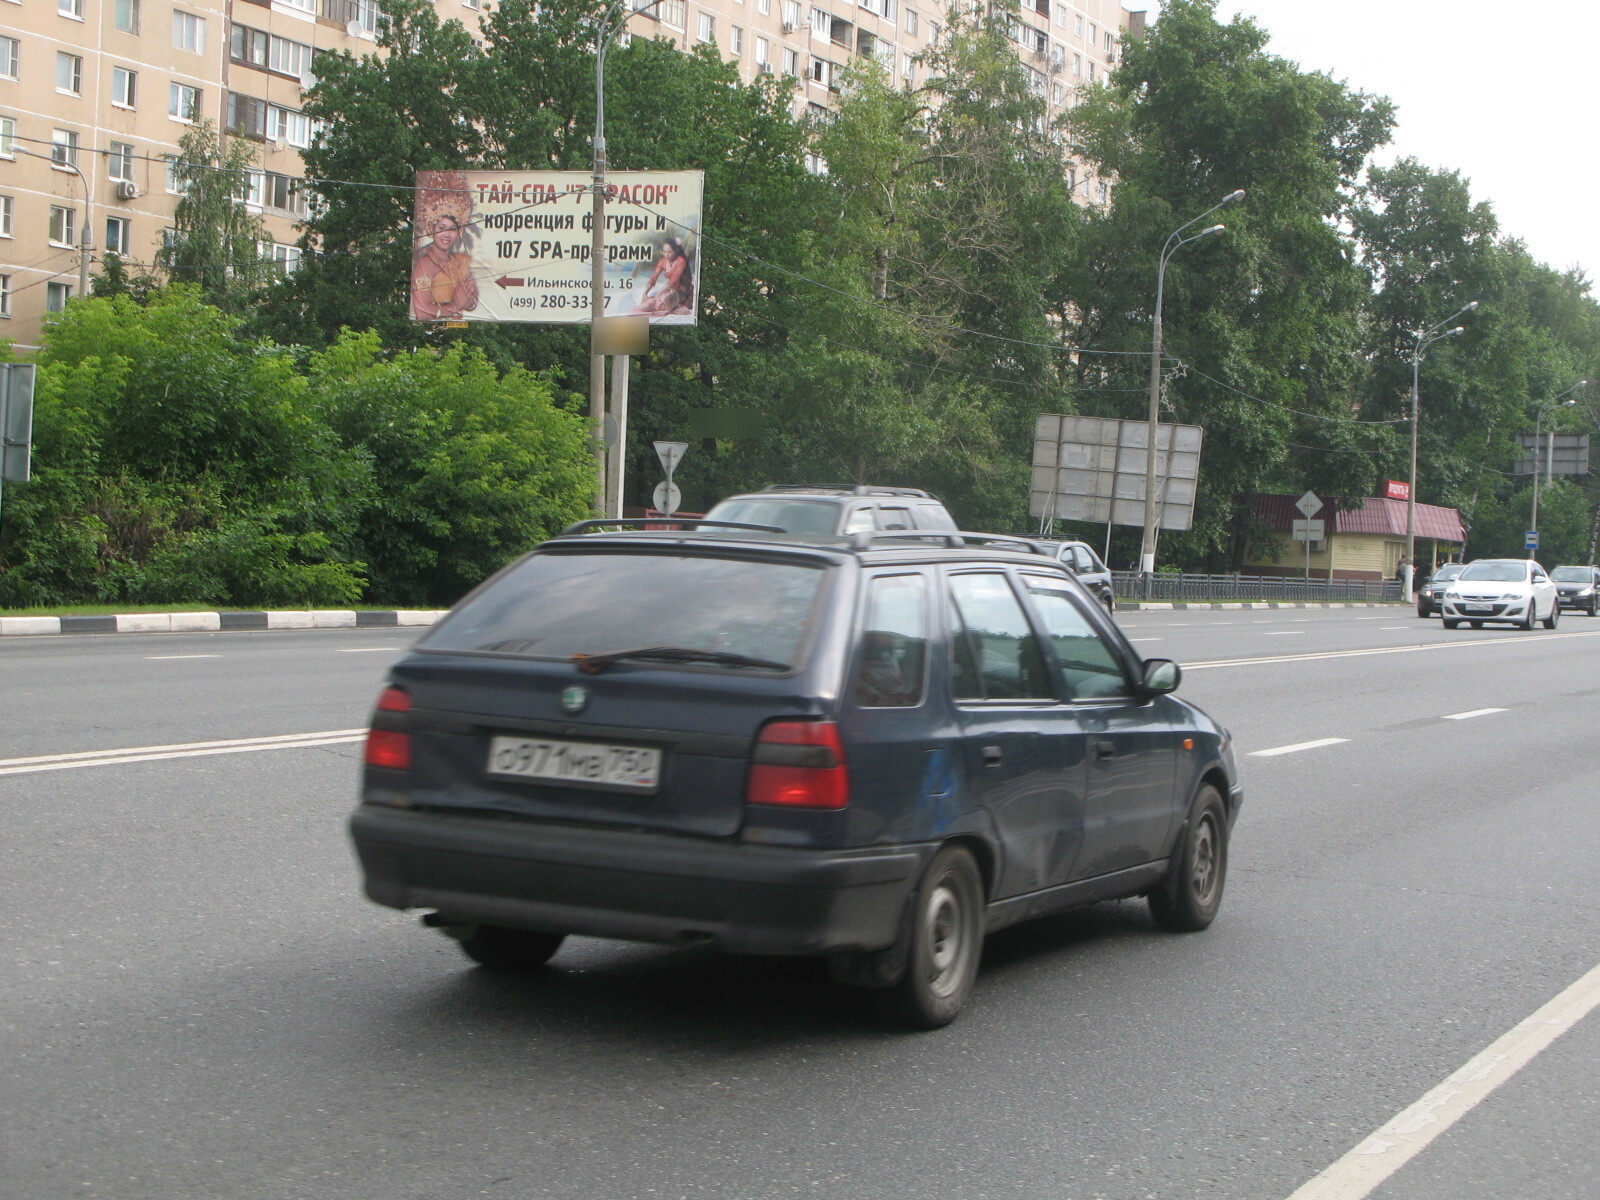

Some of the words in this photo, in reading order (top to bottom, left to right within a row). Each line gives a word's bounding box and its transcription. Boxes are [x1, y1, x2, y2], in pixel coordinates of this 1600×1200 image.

[476, 180, 557, 204] ТАЙ-СПА
[603, 183, 678, 205] РАСОК"
[484, 213, 574, 232] коррекция
[582, 211, 648, 233] фгуры
[656, 215, 666, 230] и
[496, 240, 522, 258] 107
[619, 278, 633, 289] 16
[509, 296, 536, 310] (499)
[540, 294, 611, 309] 280-33-7
